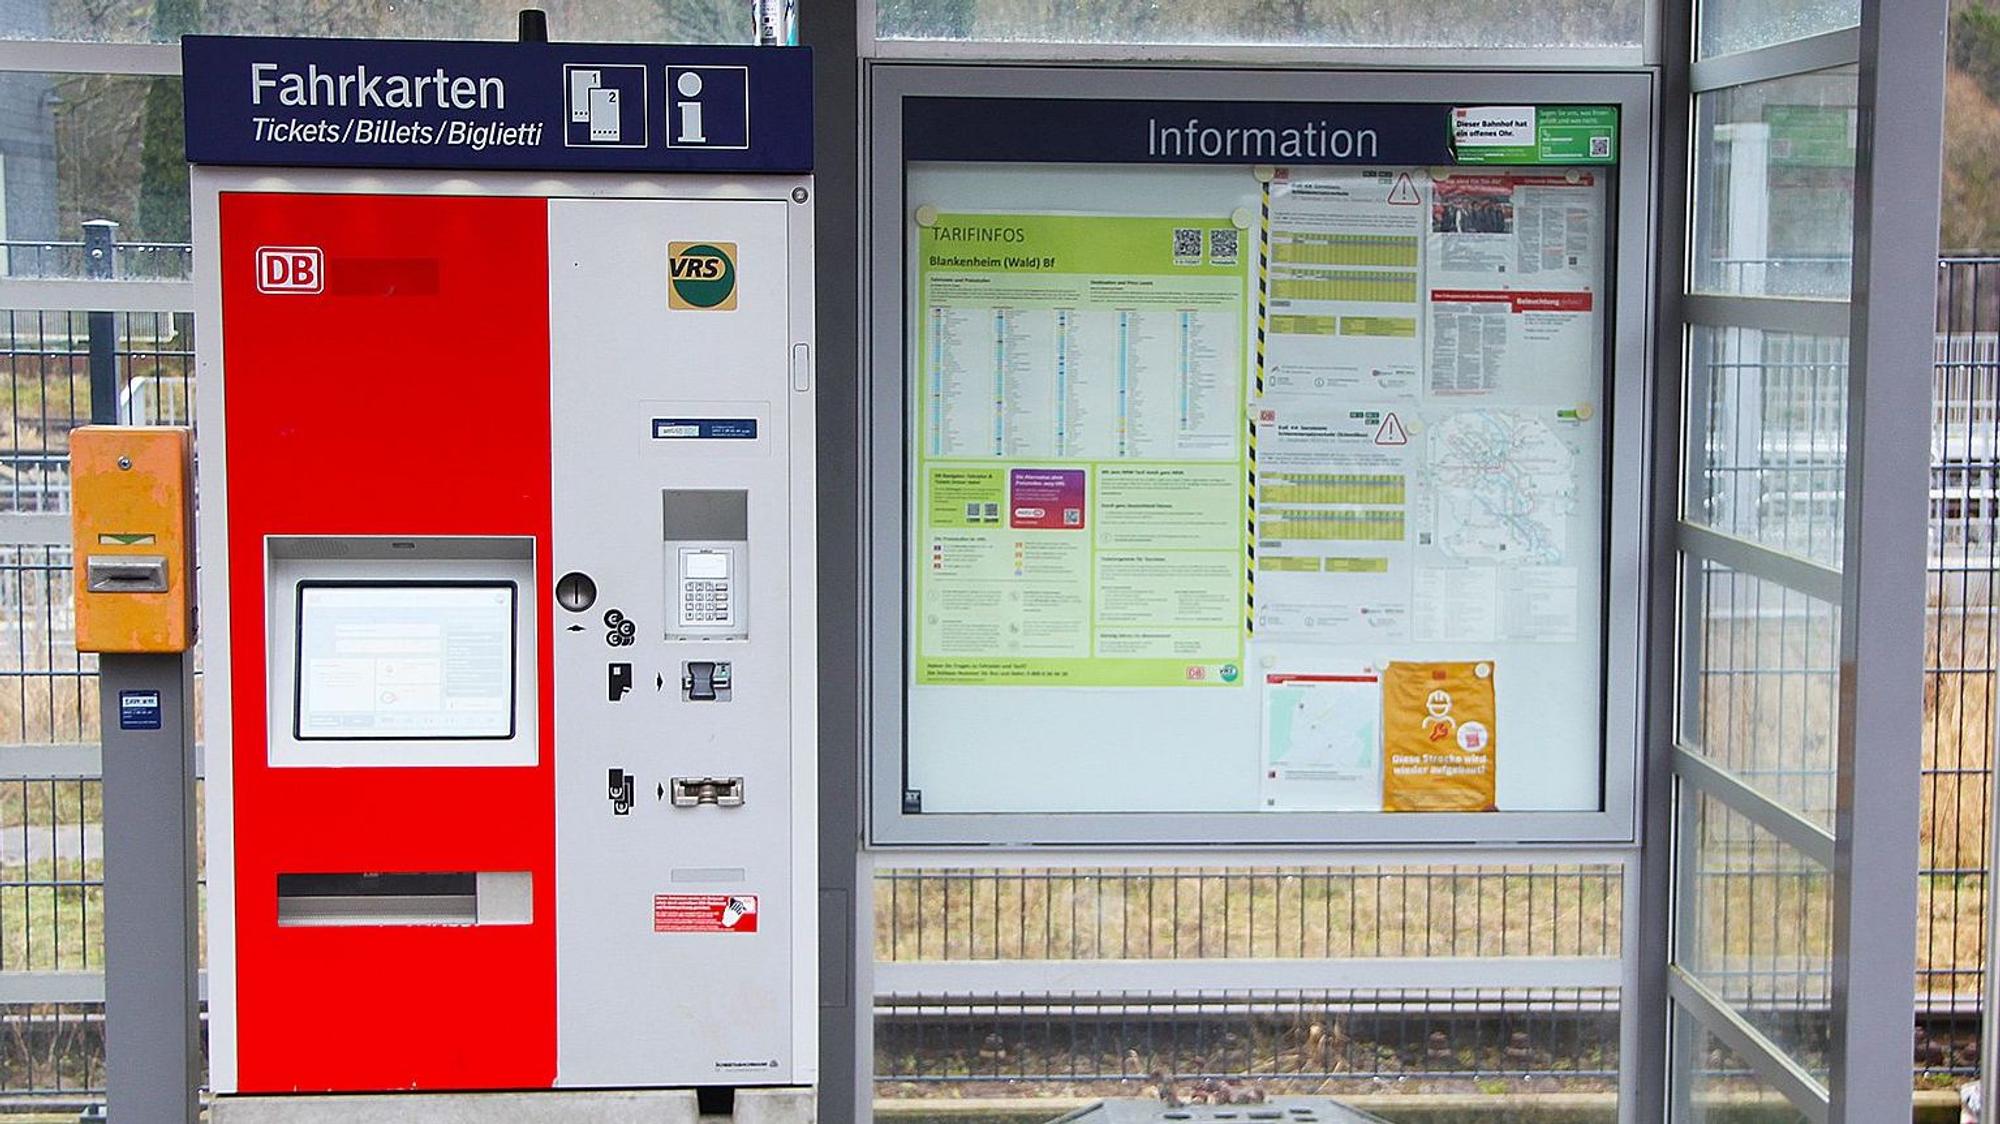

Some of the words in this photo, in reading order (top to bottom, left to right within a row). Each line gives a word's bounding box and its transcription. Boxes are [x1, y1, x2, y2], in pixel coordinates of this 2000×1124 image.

[251, 62, 505, 110] Fahrkarten
[592, 73, 598, 84] 1
[608, 92, 617, 103] 2
[1456, 120, 1480, 128] Dieser
[1482, 120, 1513, 128] Bahnhof
[1514, 120, 1528, 128] hat
[1148, 119, 1380, 159] Information
[1456, 130, 1468, 138] ein
[1469, 130, 1497, 138] offenes
[931, 226, 1025, 243] TARIFINFOS
[669, 257, 720, 278] VRS
[928, 255, 1002, 268] Blankenheim
[1003, 257, 1041, 269] (Wald)
[265, 253, 316, 287] DB
